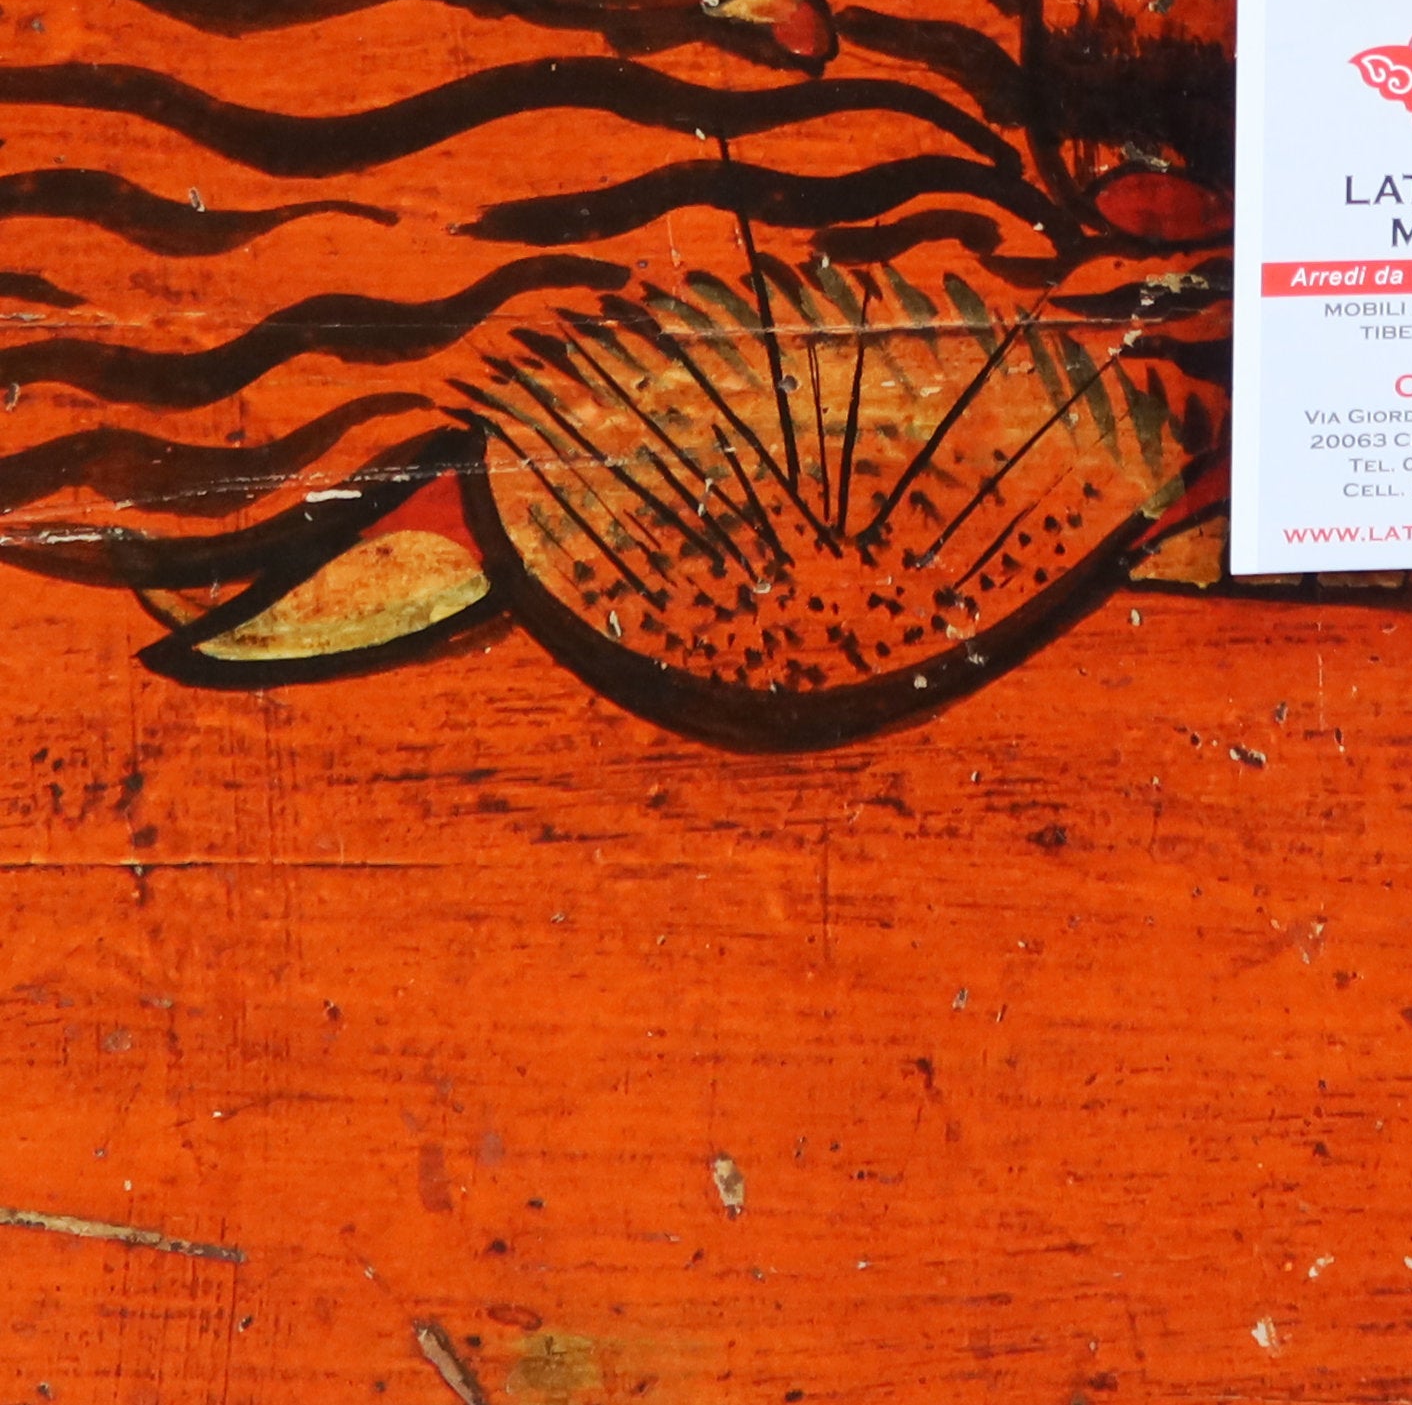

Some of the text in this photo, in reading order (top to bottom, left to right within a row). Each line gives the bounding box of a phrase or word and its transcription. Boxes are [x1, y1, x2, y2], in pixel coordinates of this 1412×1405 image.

[1291, 266, 1366, 287] Arredi
[1375, 266, 1403, 285] da
[1324, 301, 1406, 318] MOBILI
[1310, 433, 1387, 450] 20063
